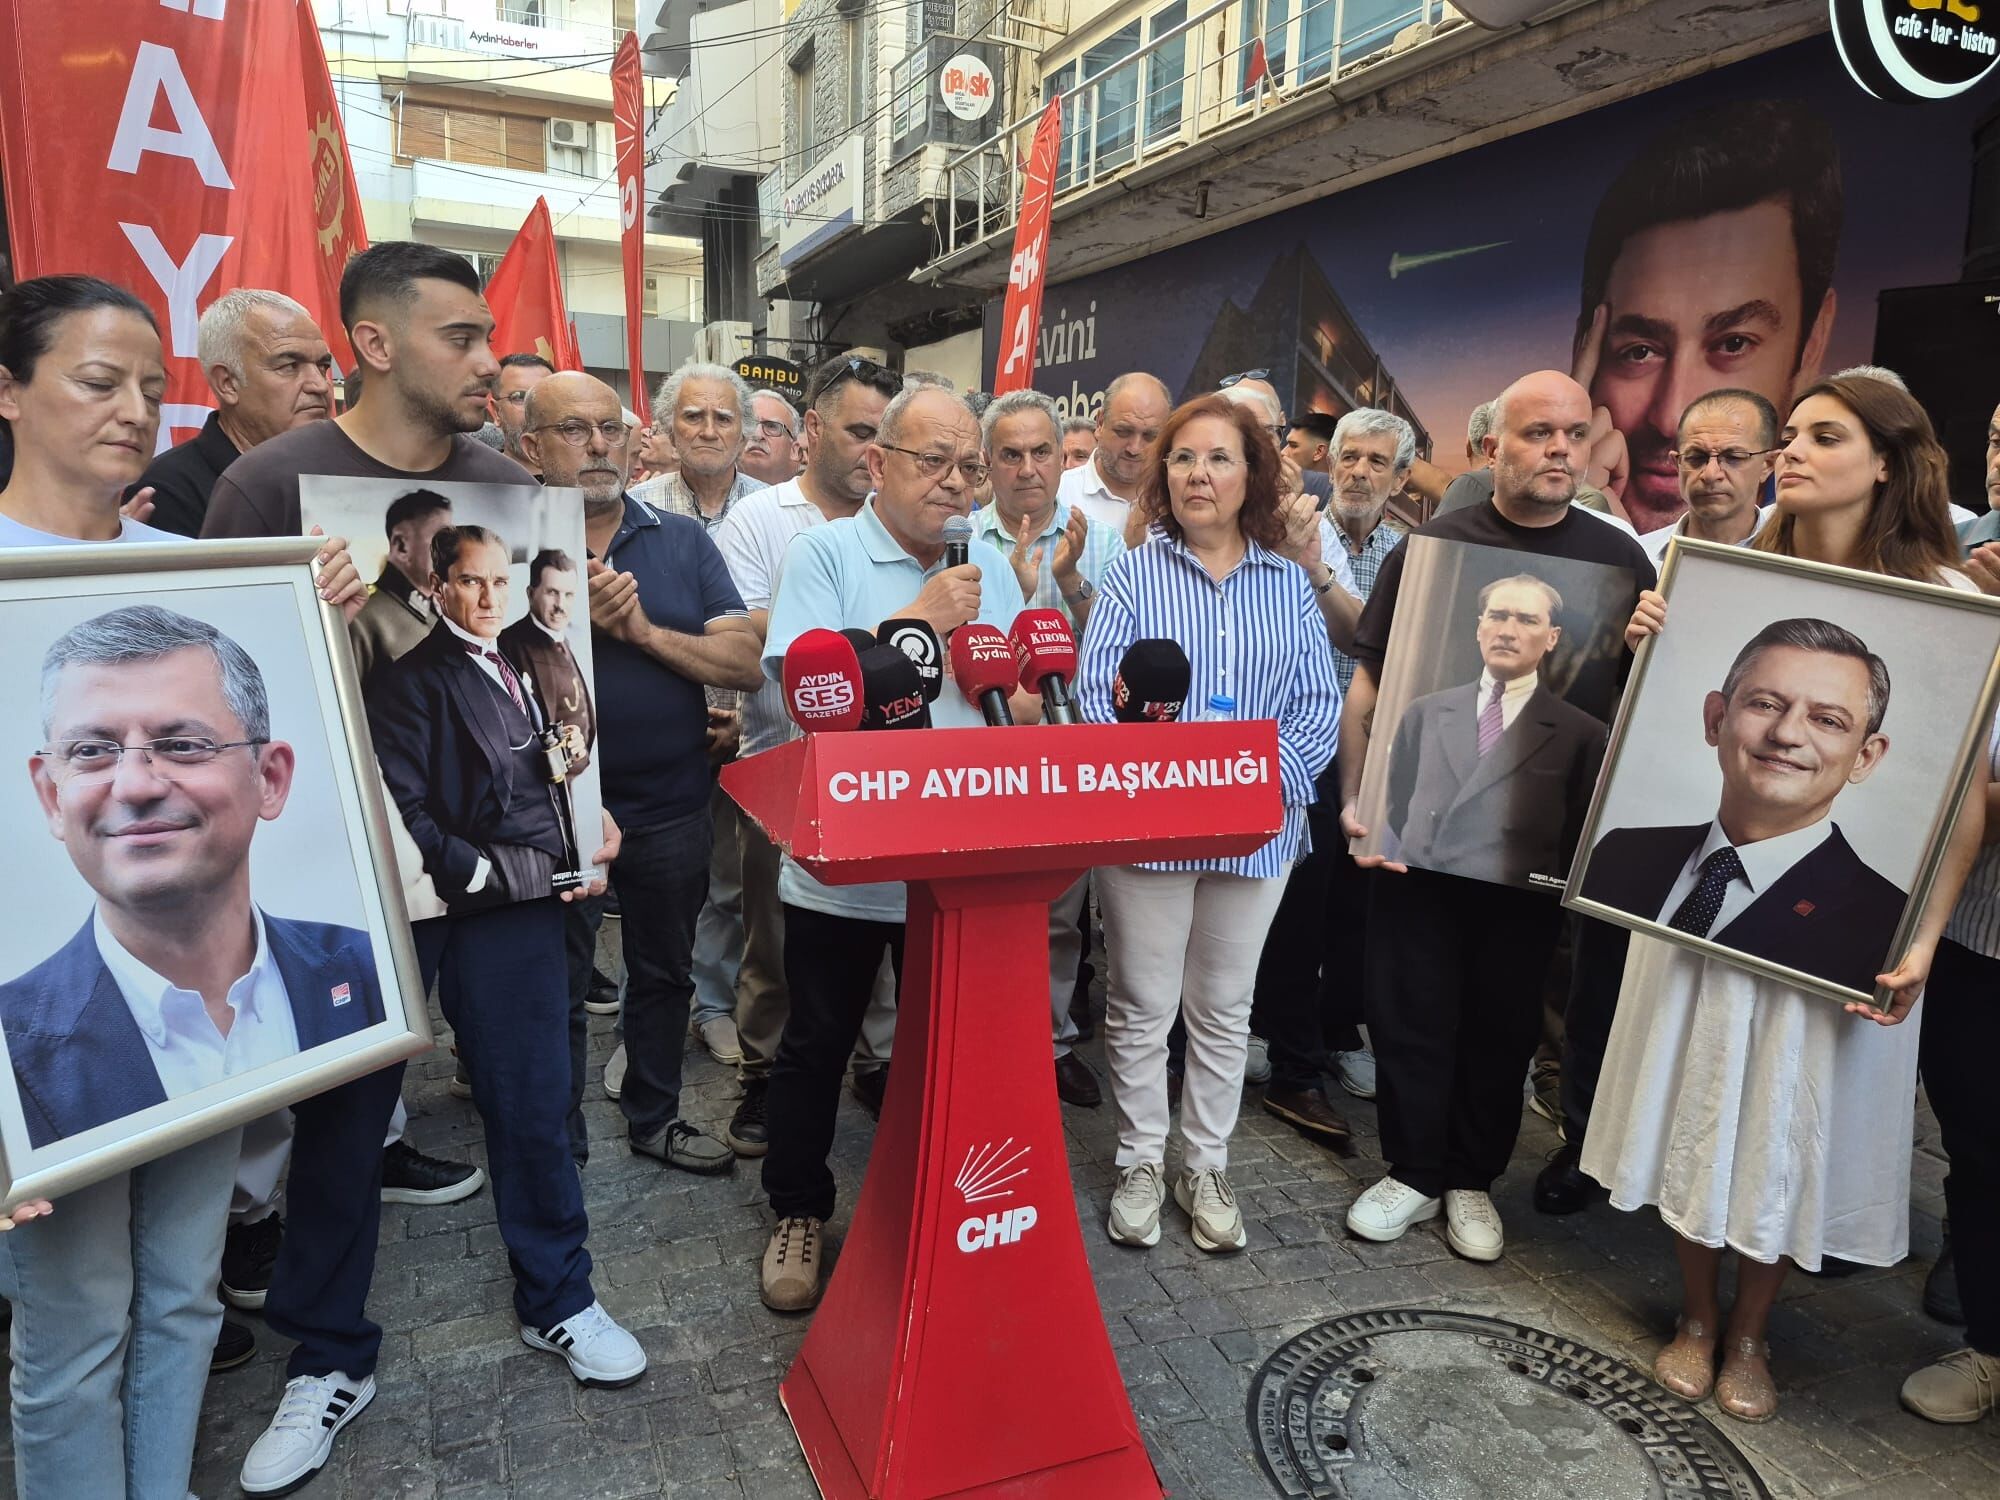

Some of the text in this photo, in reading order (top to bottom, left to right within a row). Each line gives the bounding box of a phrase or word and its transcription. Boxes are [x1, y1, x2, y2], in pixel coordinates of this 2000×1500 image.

[1894, 14, 1922, 39] cafe
[1931, 18, 1953, 46] bar
[1960, 25, 1996, 56] bistro
[740, 364, 799, 387] BAMBU
[968, 634, 1006, 646] Ajans
[1030, 632, 1072, 645] KIROBA
[972, 648, 1011, 661] Aydın
[799, 671, 844, 687] AYDIN
[799, 686, 850, 707] SES
[829, 749, 1268, 803] CHP AYDIN İL BAŞKANLIĞI
[957, 1206, 1038, 1253] CHP
